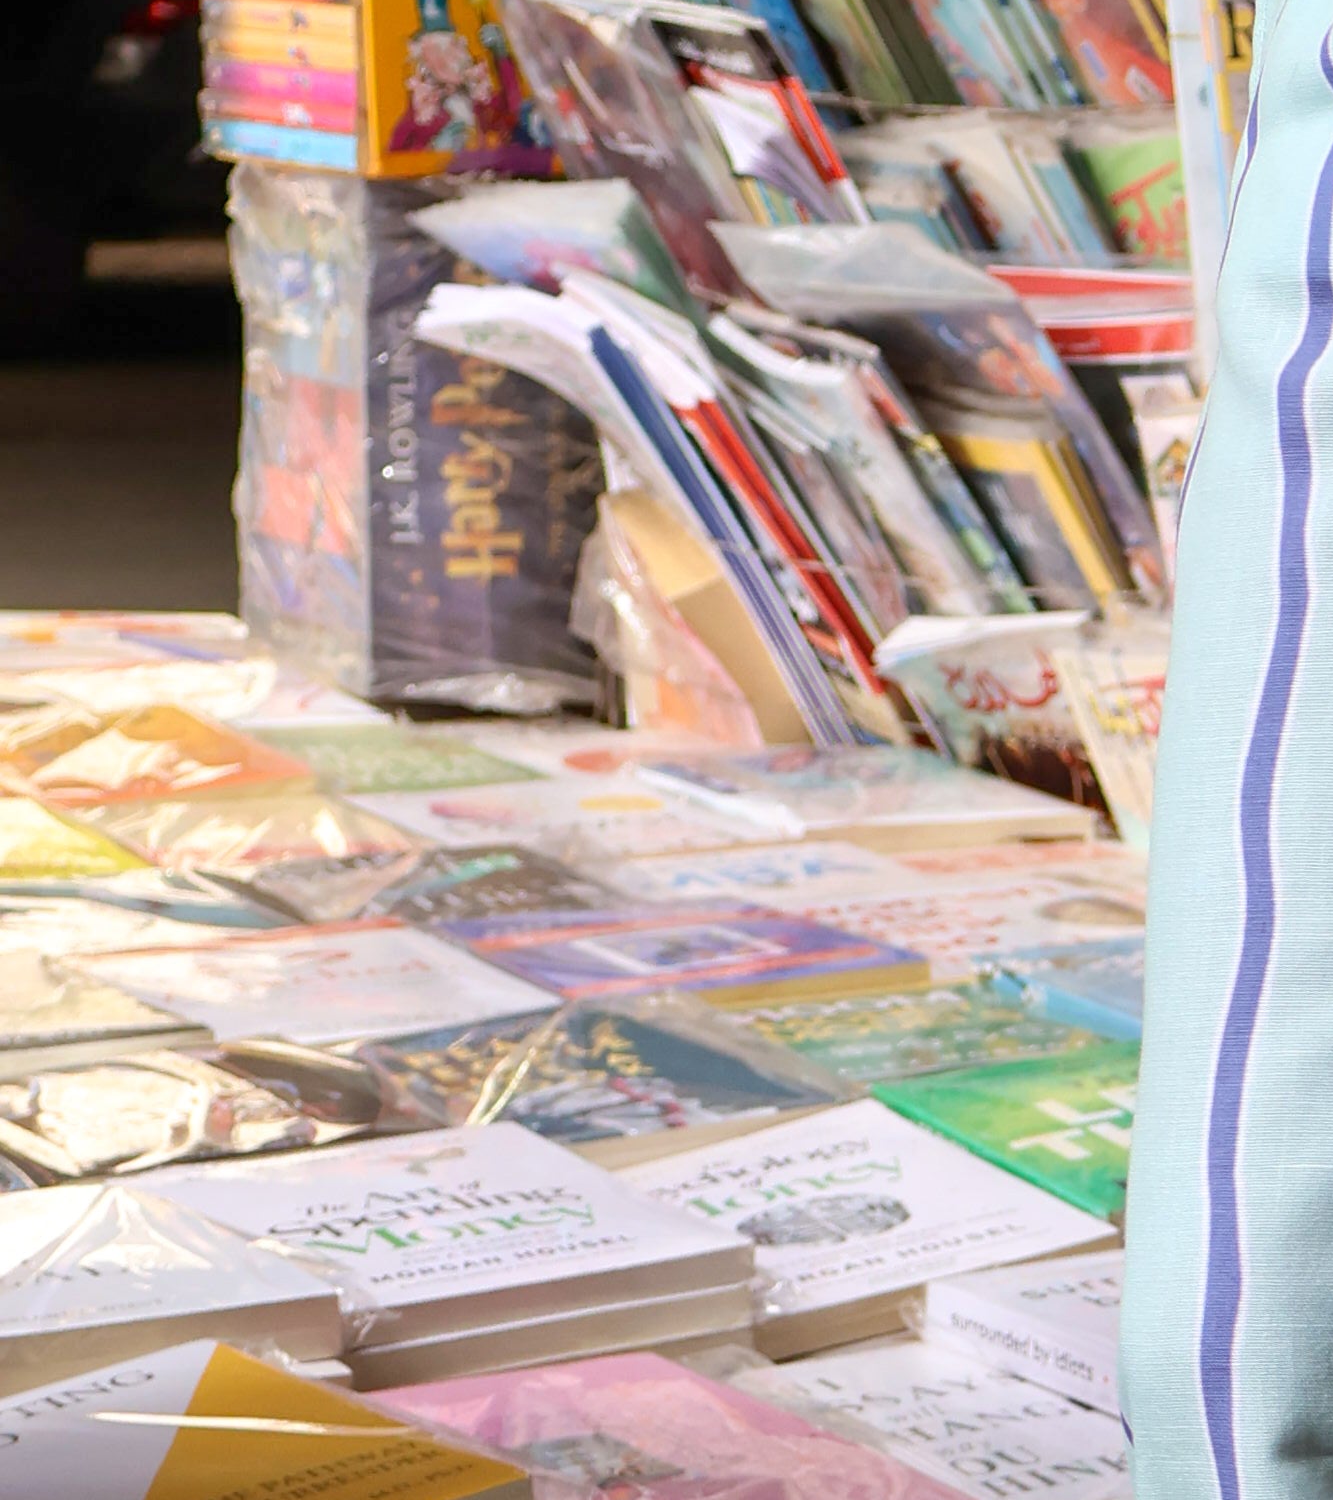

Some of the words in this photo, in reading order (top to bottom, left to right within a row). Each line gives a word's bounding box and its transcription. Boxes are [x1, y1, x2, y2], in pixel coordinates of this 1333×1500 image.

[437, 430, 525, 580] Harry
[267, 1184, 586, 1238] Spending
[303, 1202, 597, 1254] Money
[369, 1255, 504, 1285] MORGAN
[514, 1234, 639, 1261] HOUSEL
[950, 1312, 1029, 1358] surrounded
